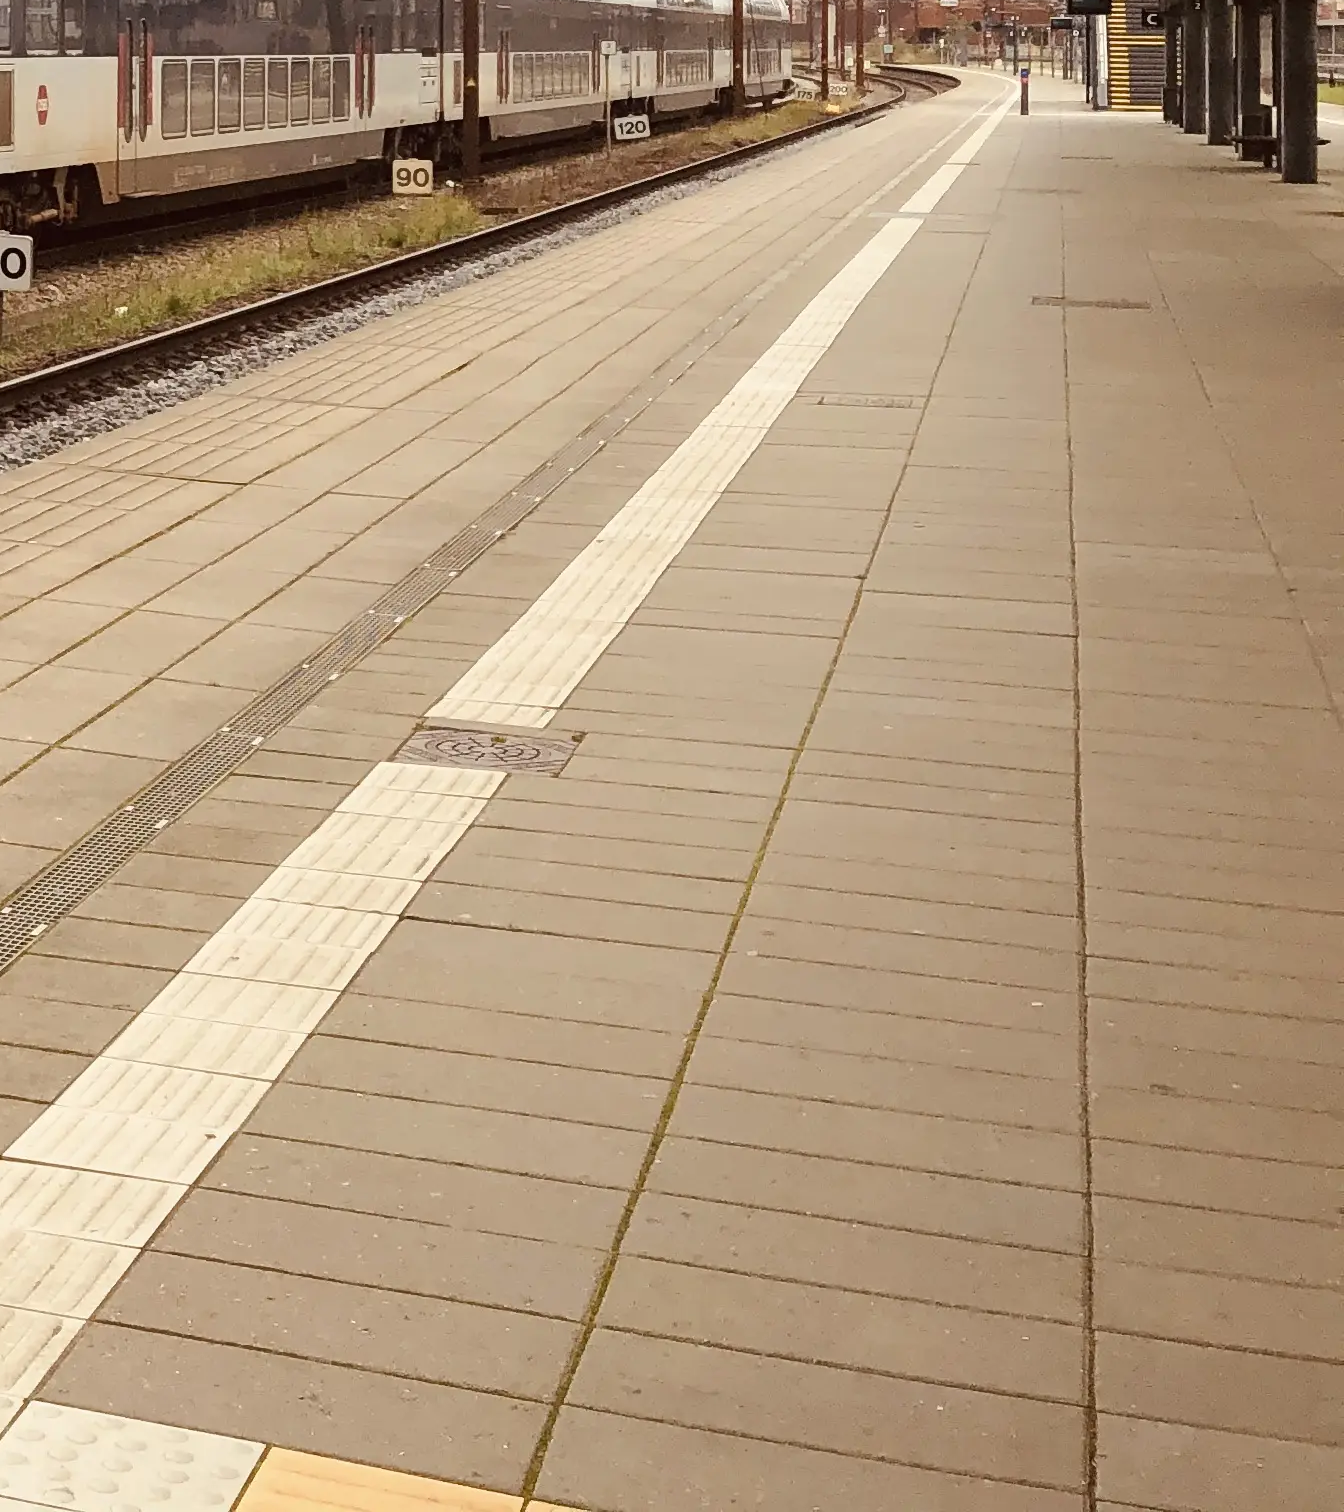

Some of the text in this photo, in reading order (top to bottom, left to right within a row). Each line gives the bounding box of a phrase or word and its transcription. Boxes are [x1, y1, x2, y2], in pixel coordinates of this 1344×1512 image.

[1146, 13, 1158, 25] C
[618, 120, 647, 136] 120
[396, 167, 430, 187] 90
